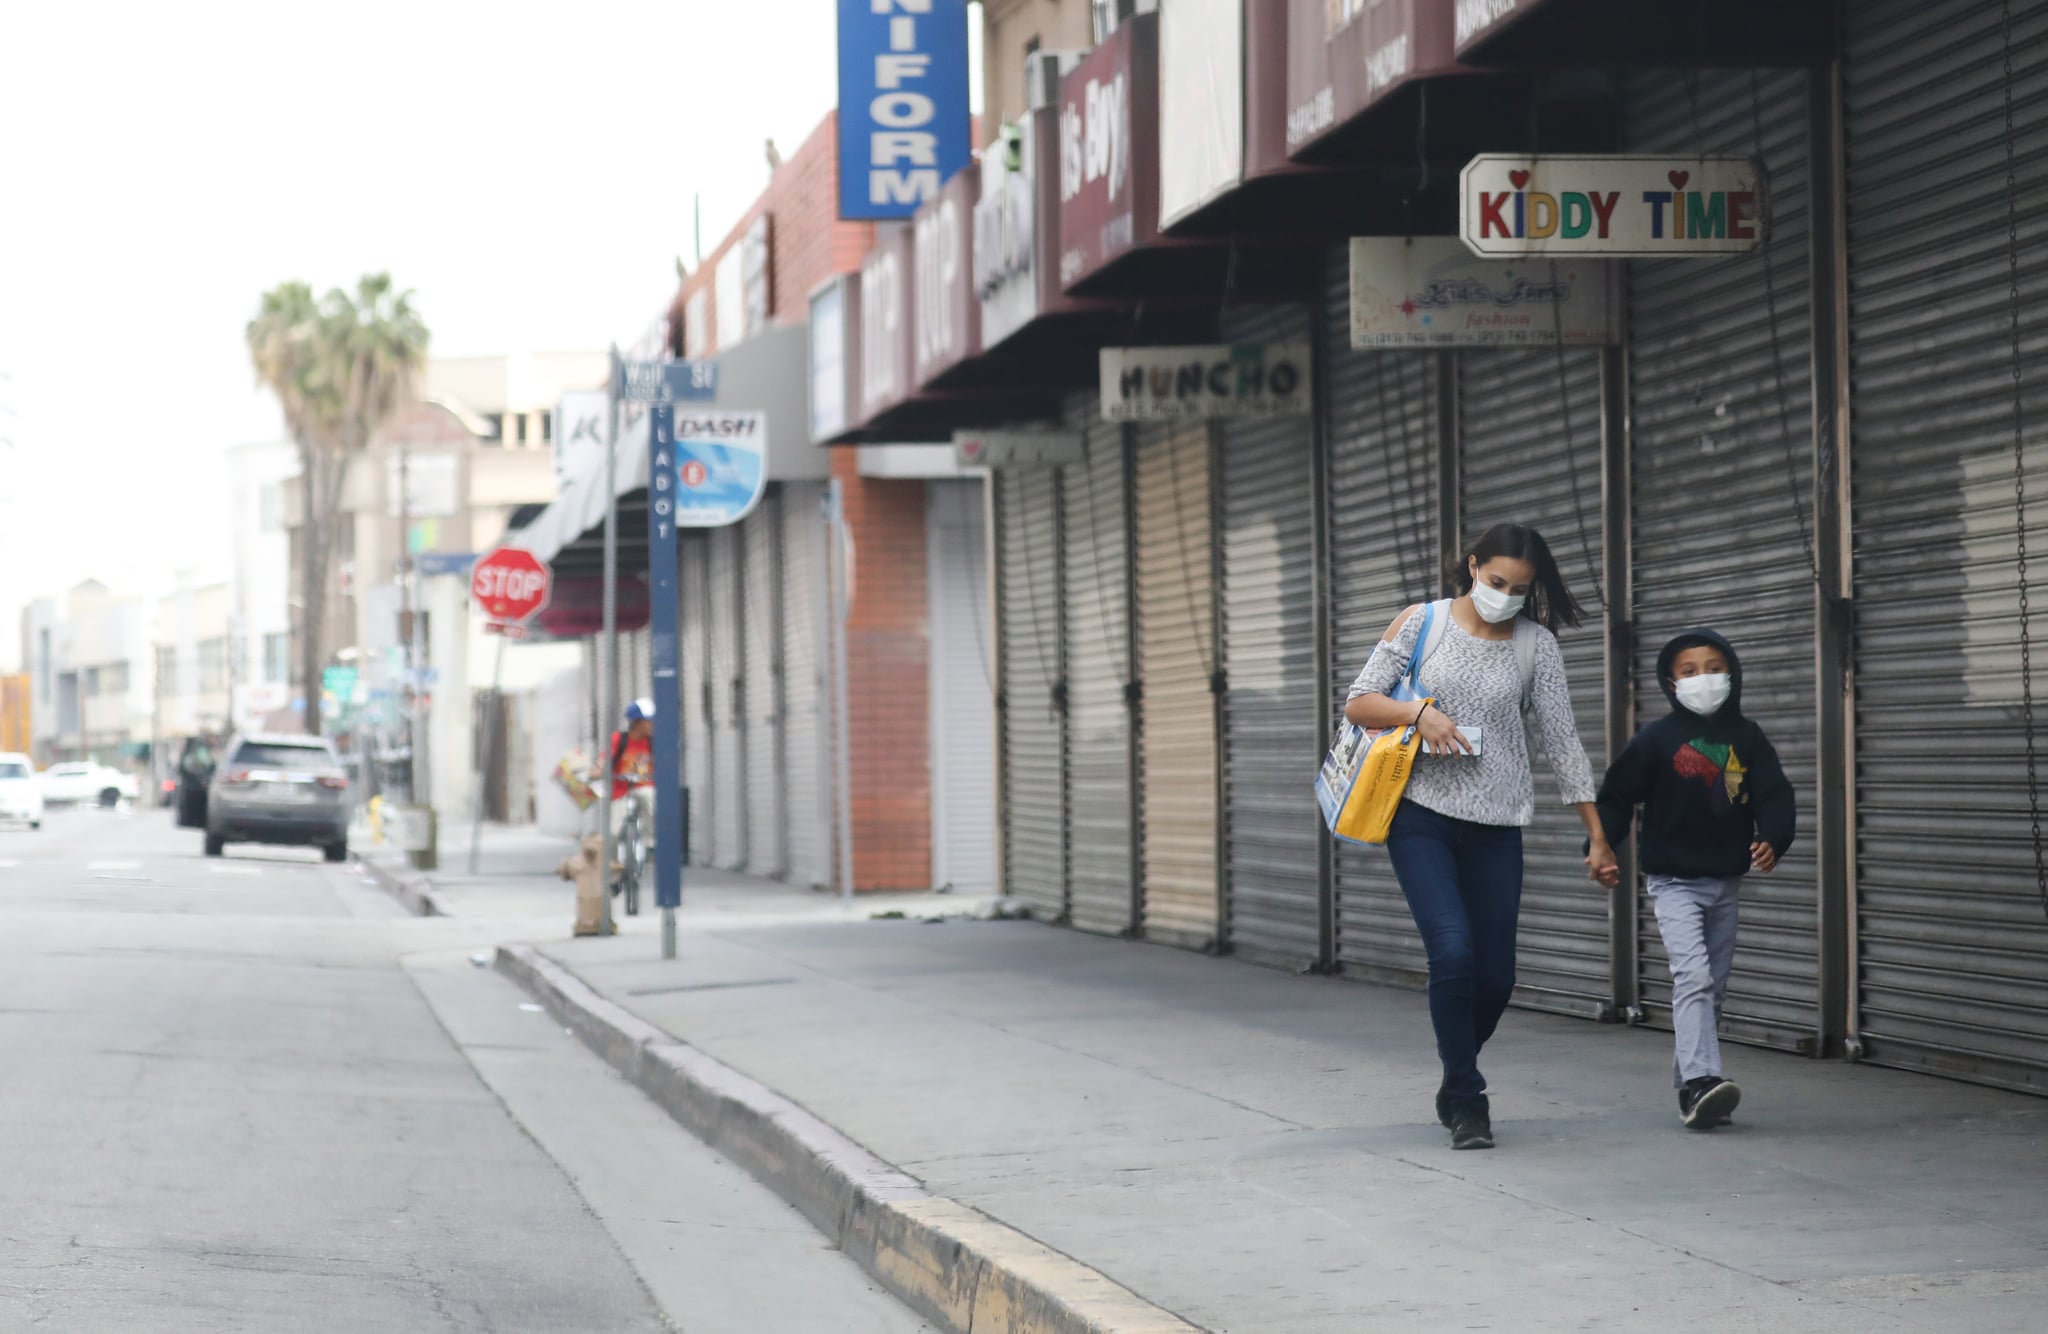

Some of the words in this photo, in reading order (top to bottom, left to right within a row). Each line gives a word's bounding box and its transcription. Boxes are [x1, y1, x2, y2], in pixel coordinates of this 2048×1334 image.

[1480, 191, 1621, 239] KIDDY
[1643, 191, 1756, 239] TIME
[625, 364, 663, 384] Wall
[679, 419, 755, 438] DASH
[475, 566, 544, 601] STOP
[1391, 747, 1408, 781] Health
